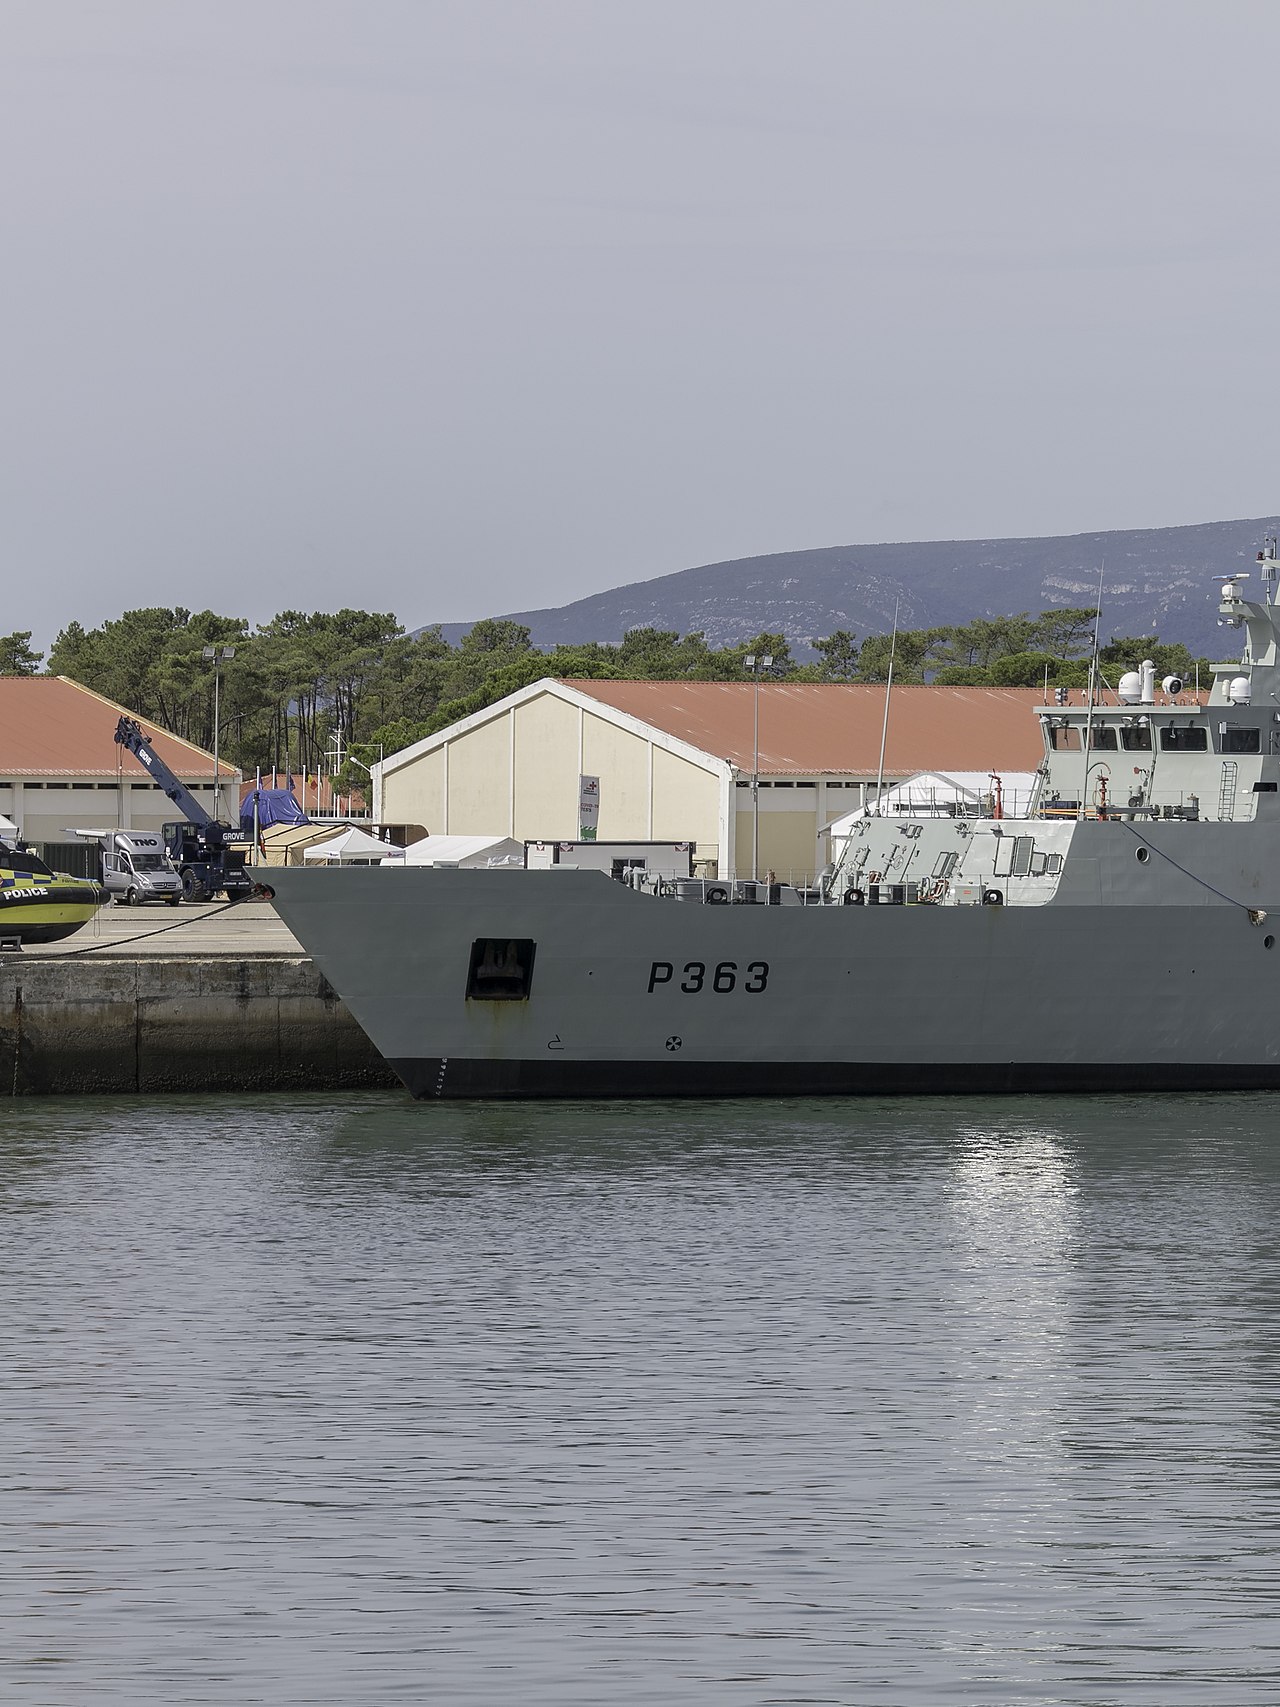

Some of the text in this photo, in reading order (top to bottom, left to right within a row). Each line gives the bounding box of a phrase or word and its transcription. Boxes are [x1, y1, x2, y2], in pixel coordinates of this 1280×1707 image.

[139, 749, 152, 765] GROVE
[222, 832, 245, 840] GROVE
[130, 839, 158, 847] TNO
[3, 887, 48, 900] POLICE
[647, 961, 769, 993] P363
